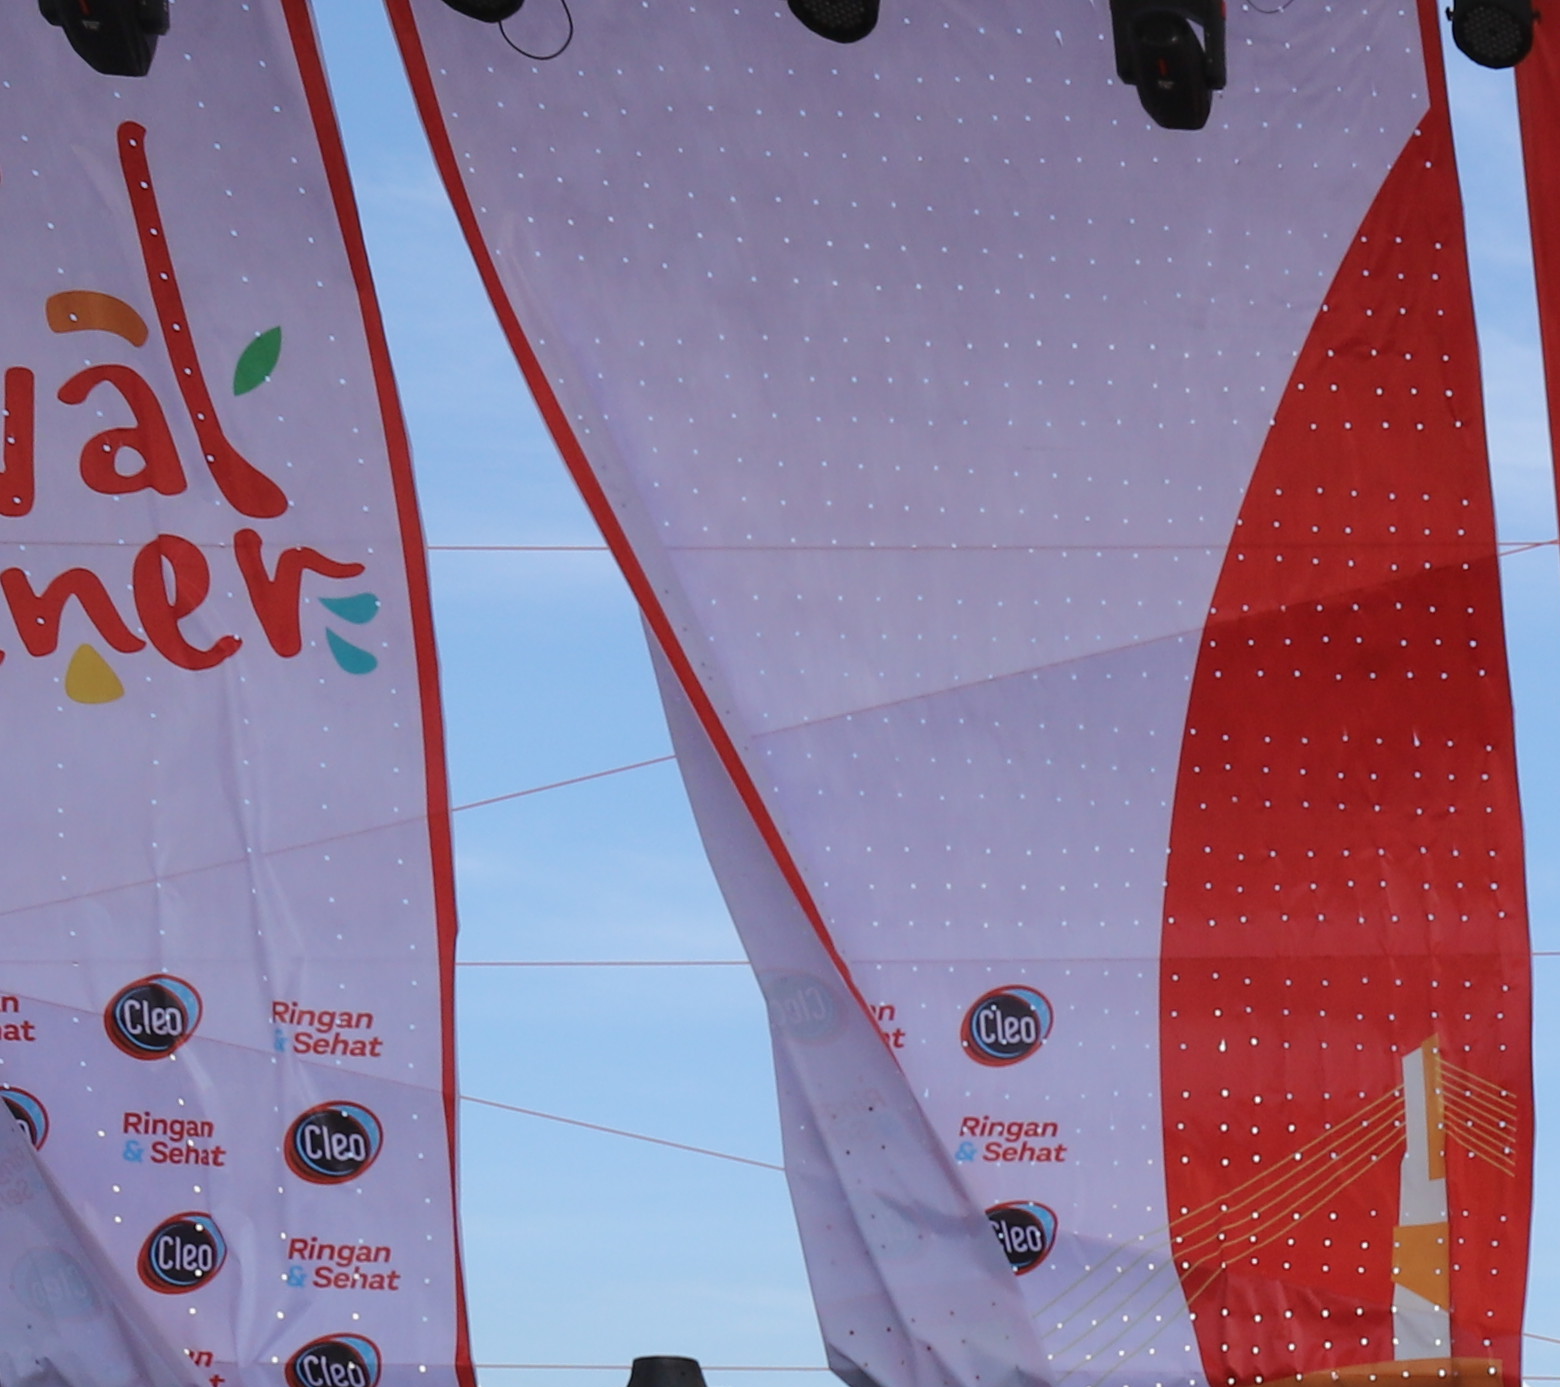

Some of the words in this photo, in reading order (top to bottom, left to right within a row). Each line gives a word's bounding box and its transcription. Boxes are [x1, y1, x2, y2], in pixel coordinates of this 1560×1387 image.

[123, 998, 184, 1036] Cleo
[272, 1000, 374, 1034] Ringan
[978, 1008, 1037, 1045] Cleo
[293, 1032, 384, 1058] Sehat
[123, 1110, 215, 1143] Ringan
[959, 1115, 1059, 1143] Ringan
[122, 1139, 145, 1163] &
[150, 1140, 227, 1167] Sehat
[303, 1125, 368, 1163] Cleo
[954, 1140, 979, 1163] &
[982, 1141, 1068, 1164] Sehat
[158, 1235, 213, 1273] Cleo
[288, 1237, 392, 1267] Ringan
[286, 1265, 307, 1288] &
[312, 1266, 401, 1291] Sehat
